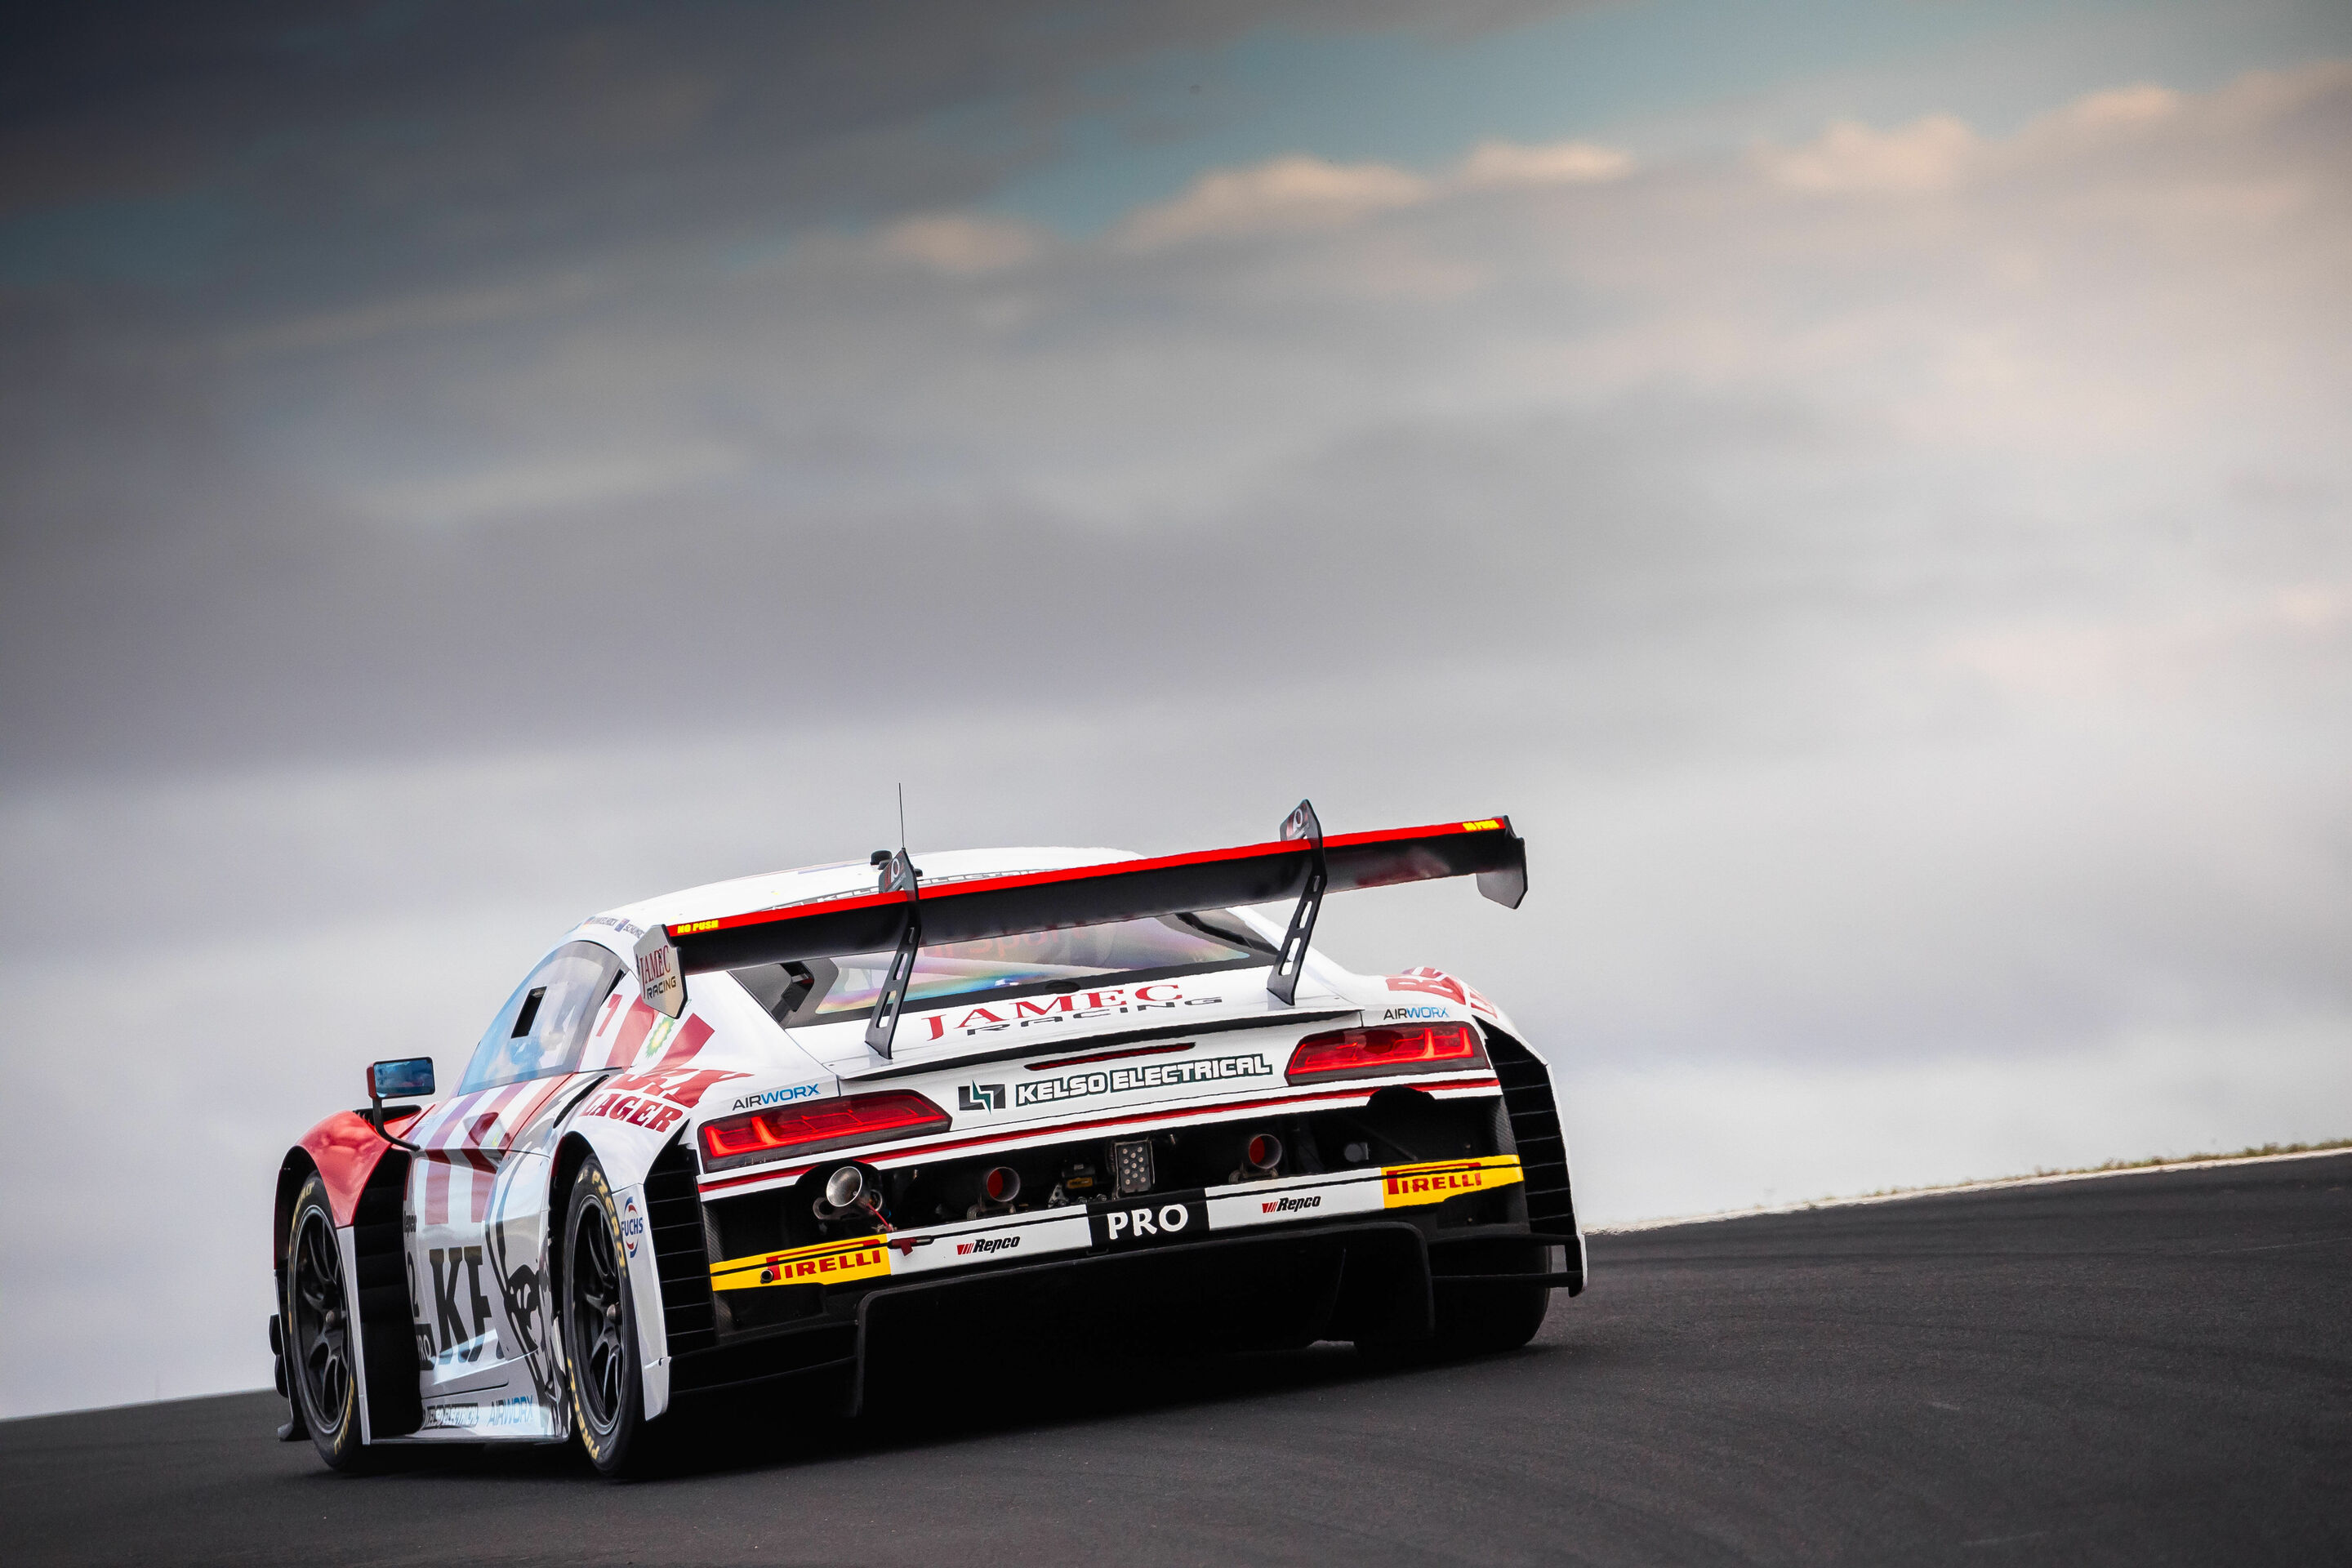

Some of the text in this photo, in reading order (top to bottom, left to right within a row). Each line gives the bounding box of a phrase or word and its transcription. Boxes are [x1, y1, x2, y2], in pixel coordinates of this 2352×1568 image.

[677, 919, 719, 934] NO PUSH
[639, 945, 670, 999] JAMEC
[647, 976, 677, 1000] RACING
[921, 984, 1183, 1041] JAMEC
[967, 996, 1222, 1036] RACING
[1383, 1007, 1450, 1021] AIRWORX
[1017, 1054, 1273, 1106] KELSO ELECTRICAL
[579, 1093, 684, 1133] LAGER
[733, 1083, 821, 1111] AIRWORX
[1386, 1162, 1481, 1195] PIRELLI
[1276, 1196, 1321, 1213] Repco
[621, 1217, 644, 1236] FUCHS
[1107, 1204, 1188, 1240] PRO
[766, 1238, 881, 1281] PIRELLI
[973, 1236, 1021, 1254] Repco
